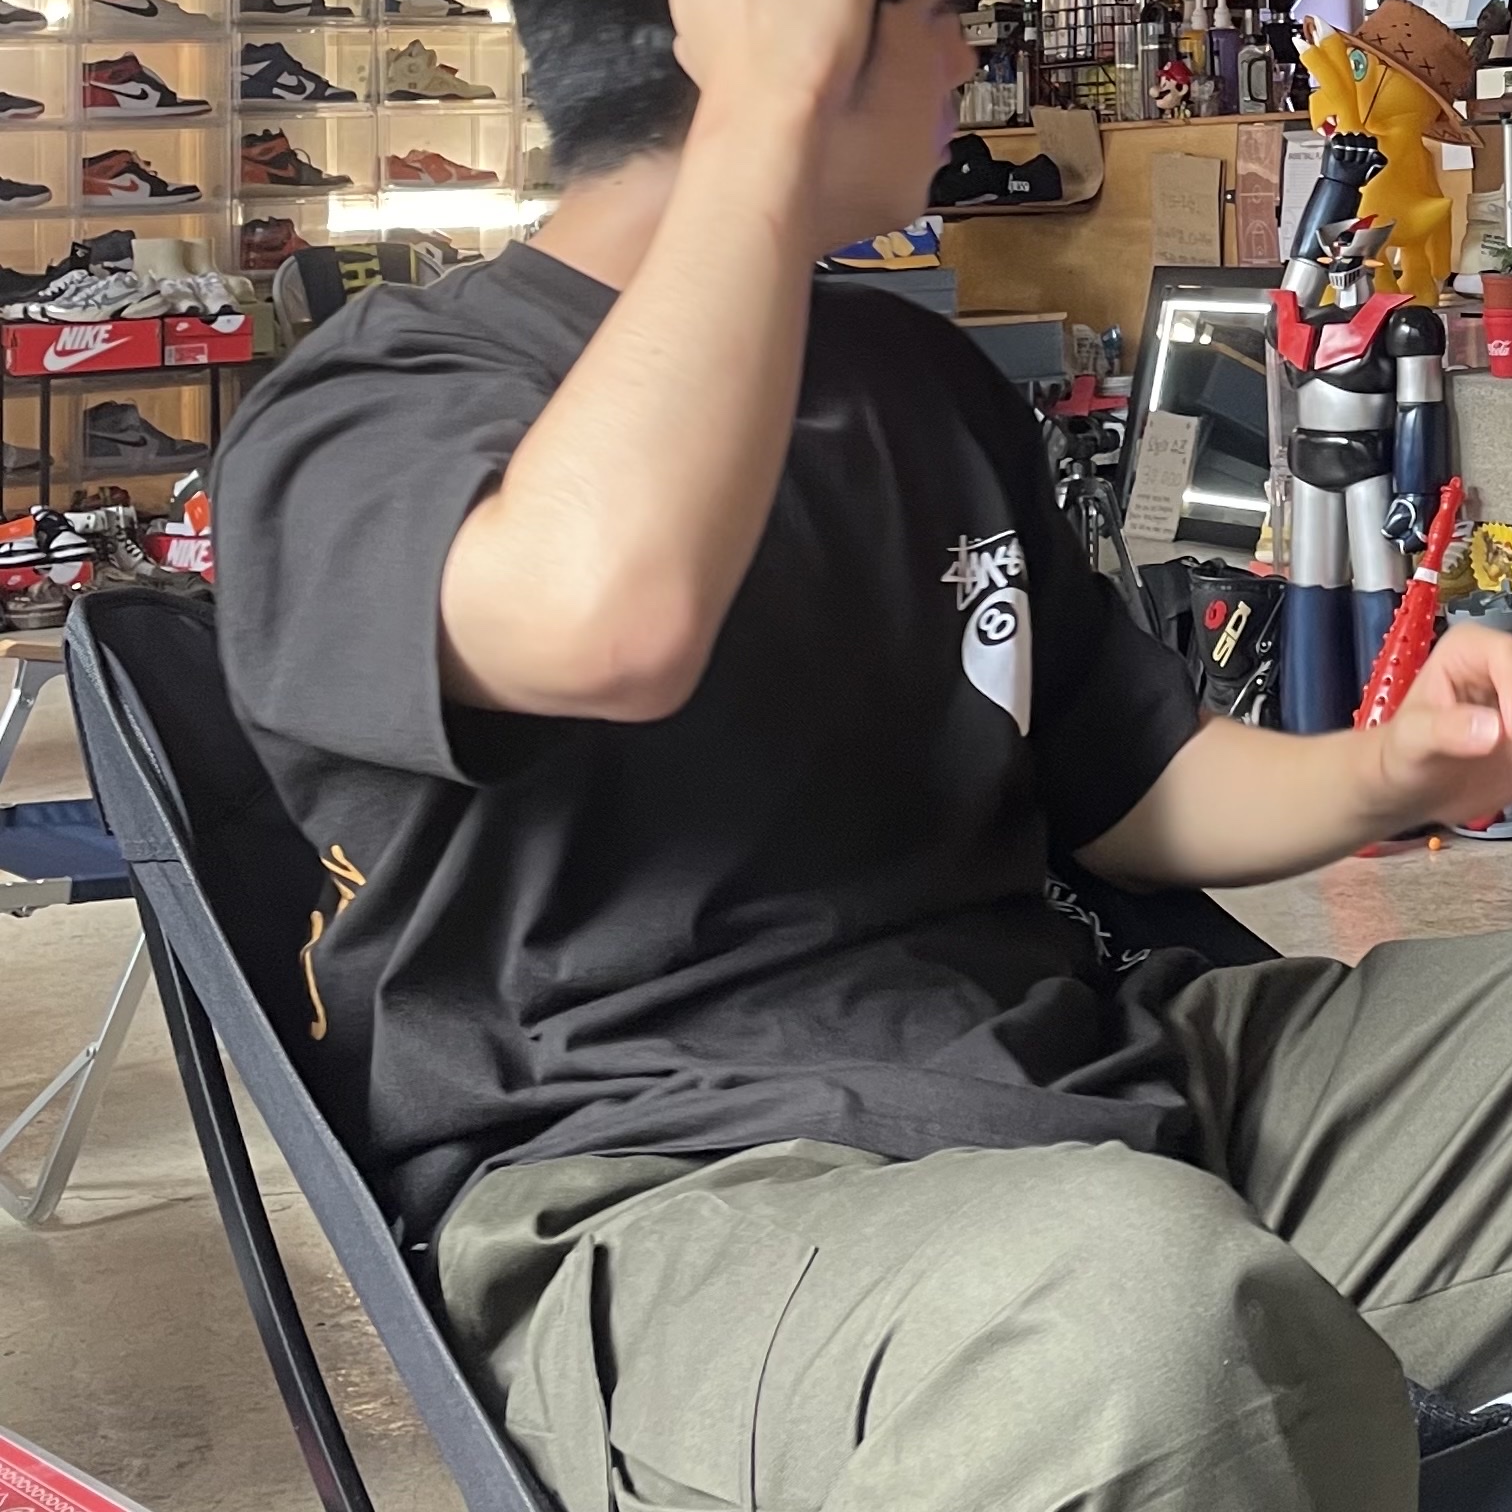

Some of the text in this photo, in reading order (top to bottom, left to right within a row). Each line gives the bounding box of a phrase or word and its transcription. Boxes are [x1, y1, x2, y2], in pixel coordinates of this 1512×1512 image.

[56, 325, 113, 351] NIKE
[166, 539, 213, 569] NIKE
[979, 608, 1016, 640] 8
